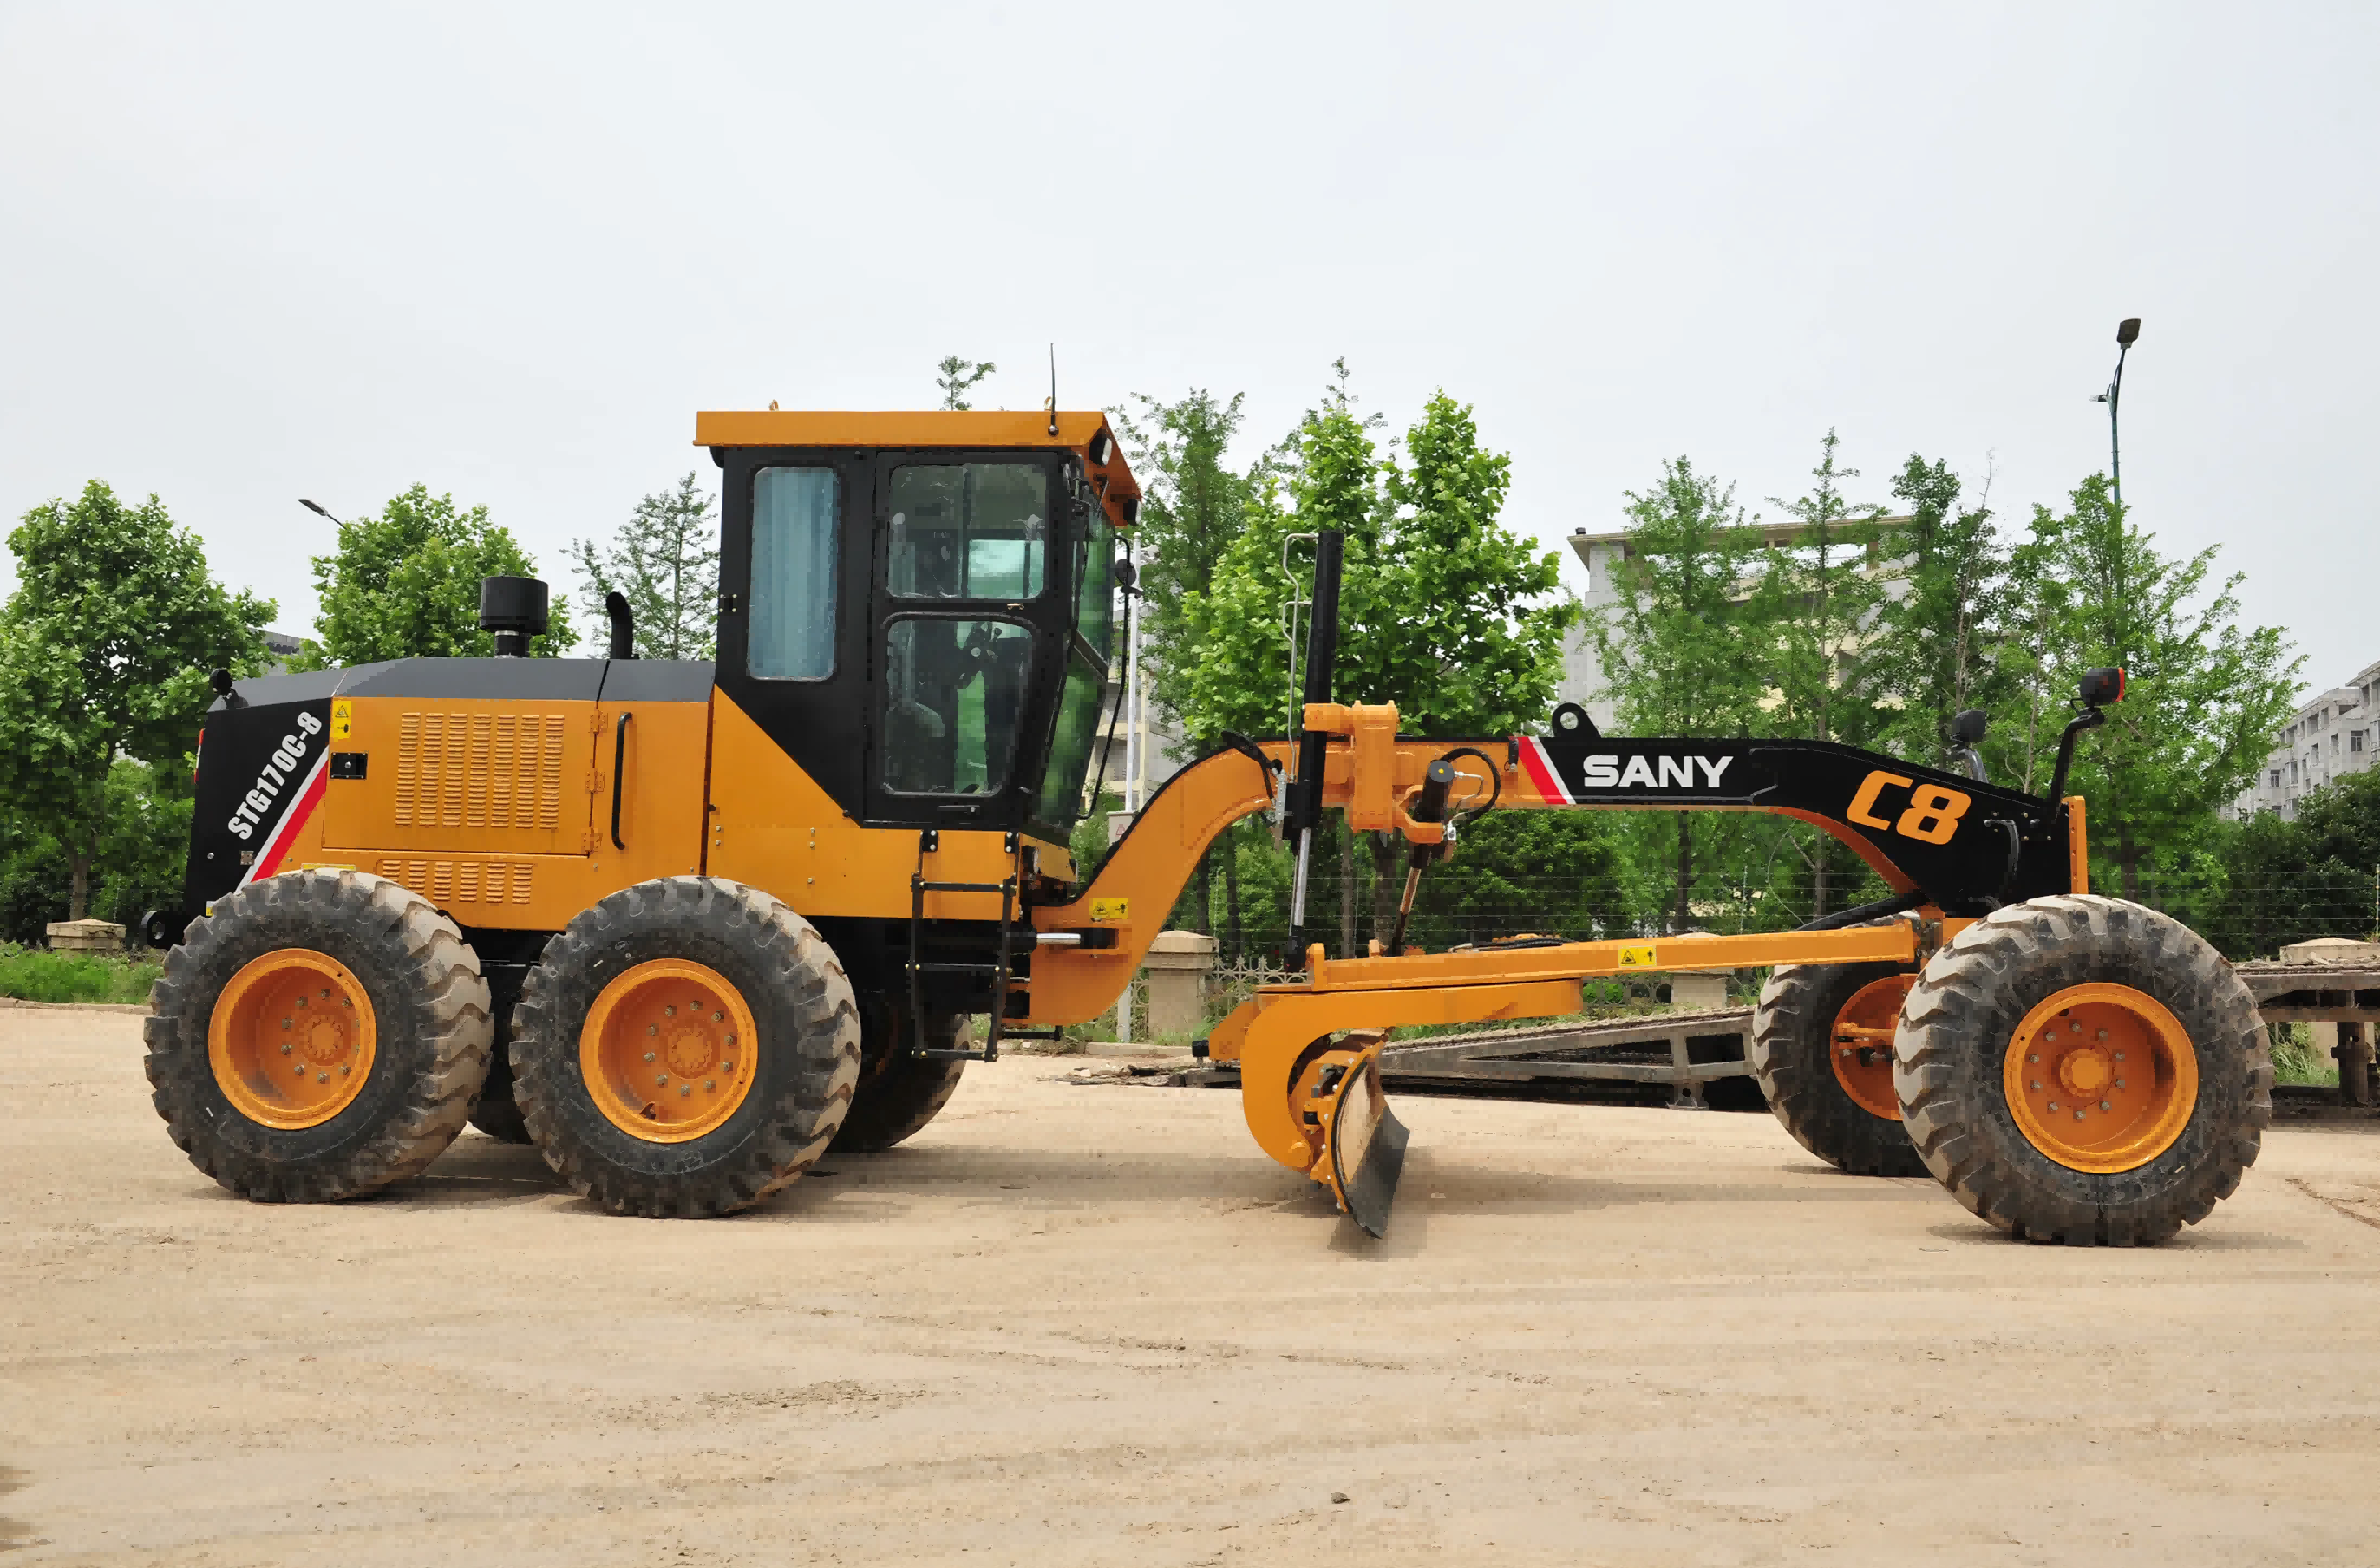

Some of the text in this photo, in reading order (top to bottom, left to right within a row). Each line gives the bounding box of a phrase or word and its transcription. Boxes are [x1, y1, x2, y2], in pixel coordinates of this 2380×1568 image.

[228, 711, 322, 840] STG170C-8
[1583, 755, 1734, 787] SANY
[1847, 770, 1972, 845] C8
